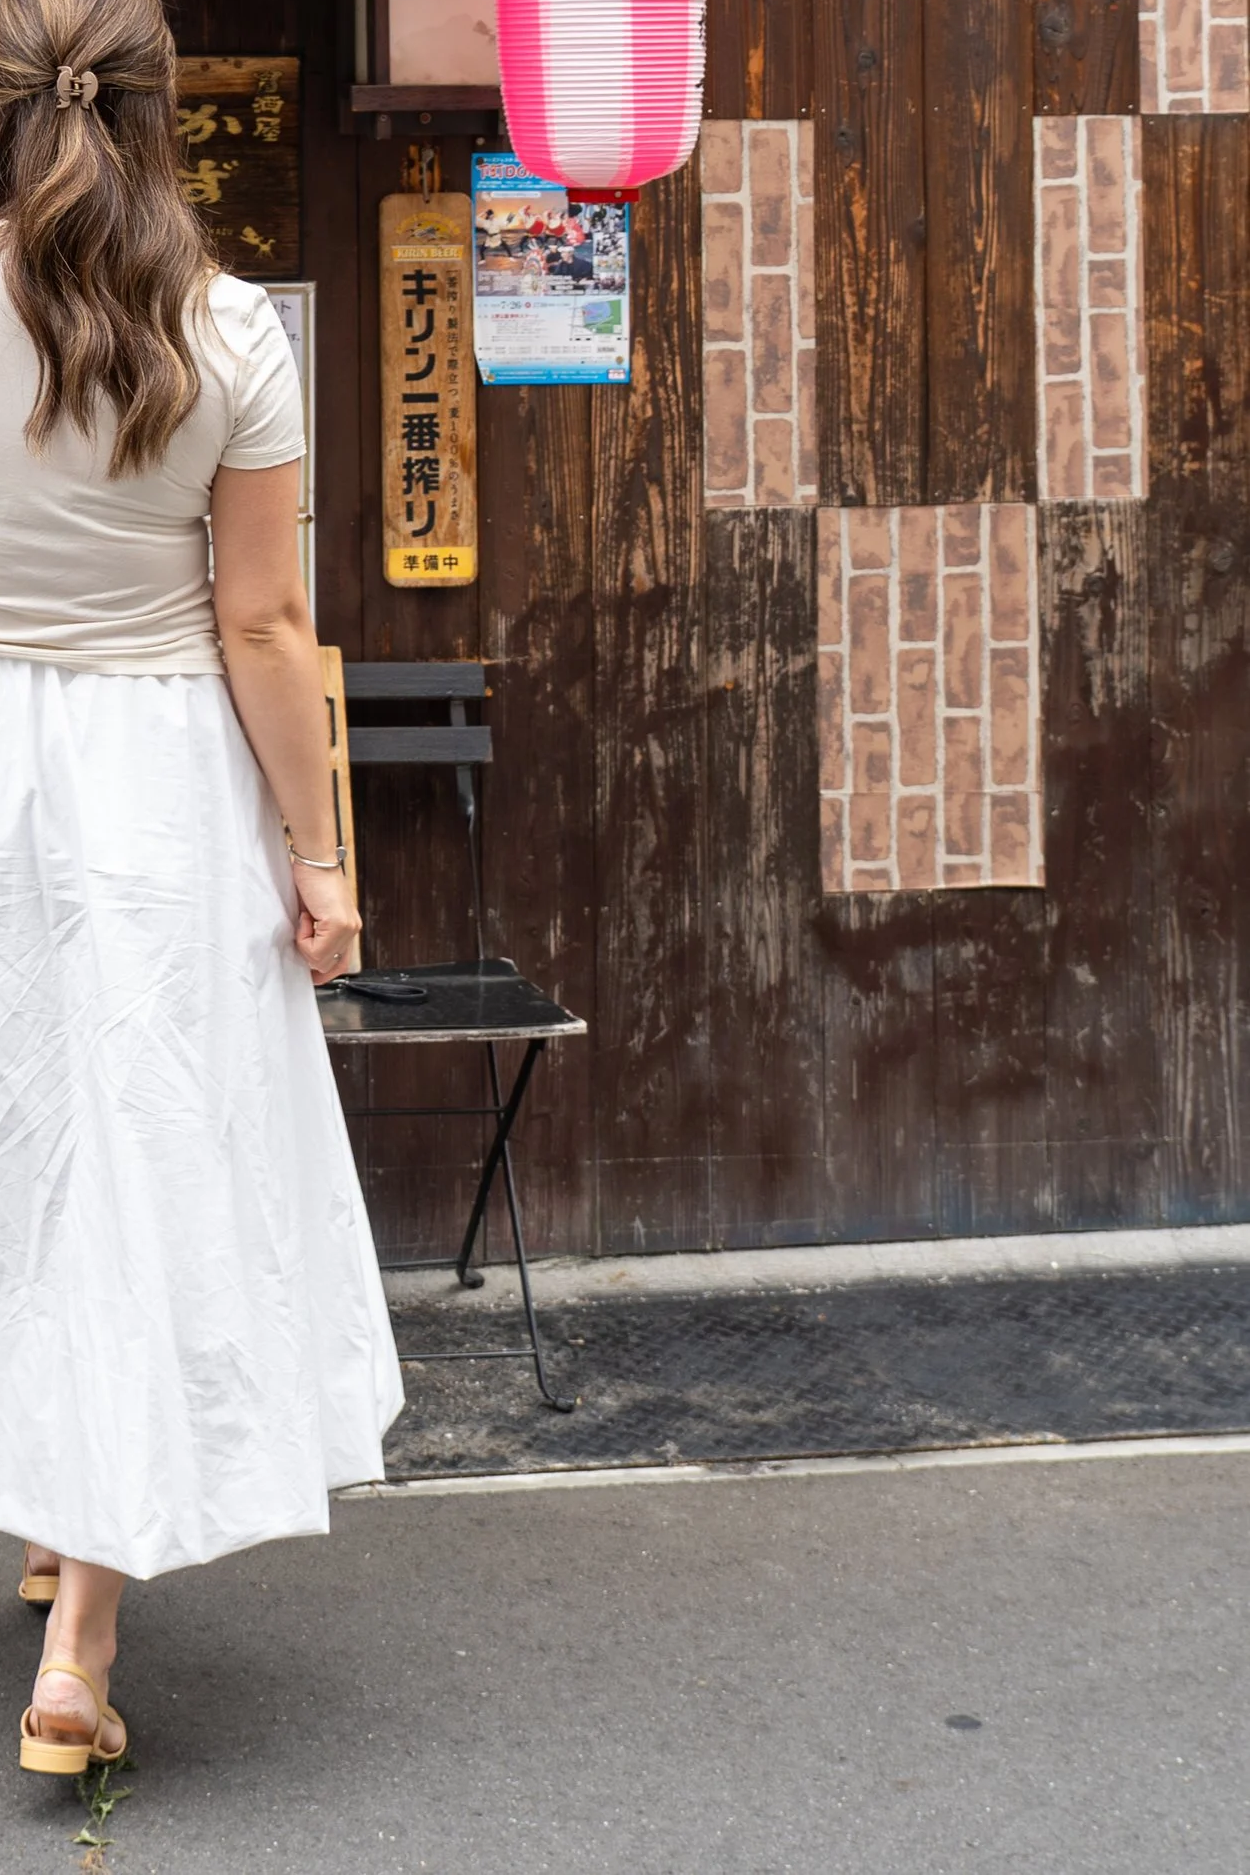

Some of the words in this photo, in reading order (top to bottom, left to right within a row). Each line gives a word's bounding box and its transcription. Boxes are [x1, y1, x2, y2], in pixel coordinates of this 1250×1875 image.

[397, 248, 428, 258] KIRIN
[431, 248, 458, 258] BEER
[402, 269, 440, 538] キリン一番搾り
[403, 554, 459, 571] 準備中
